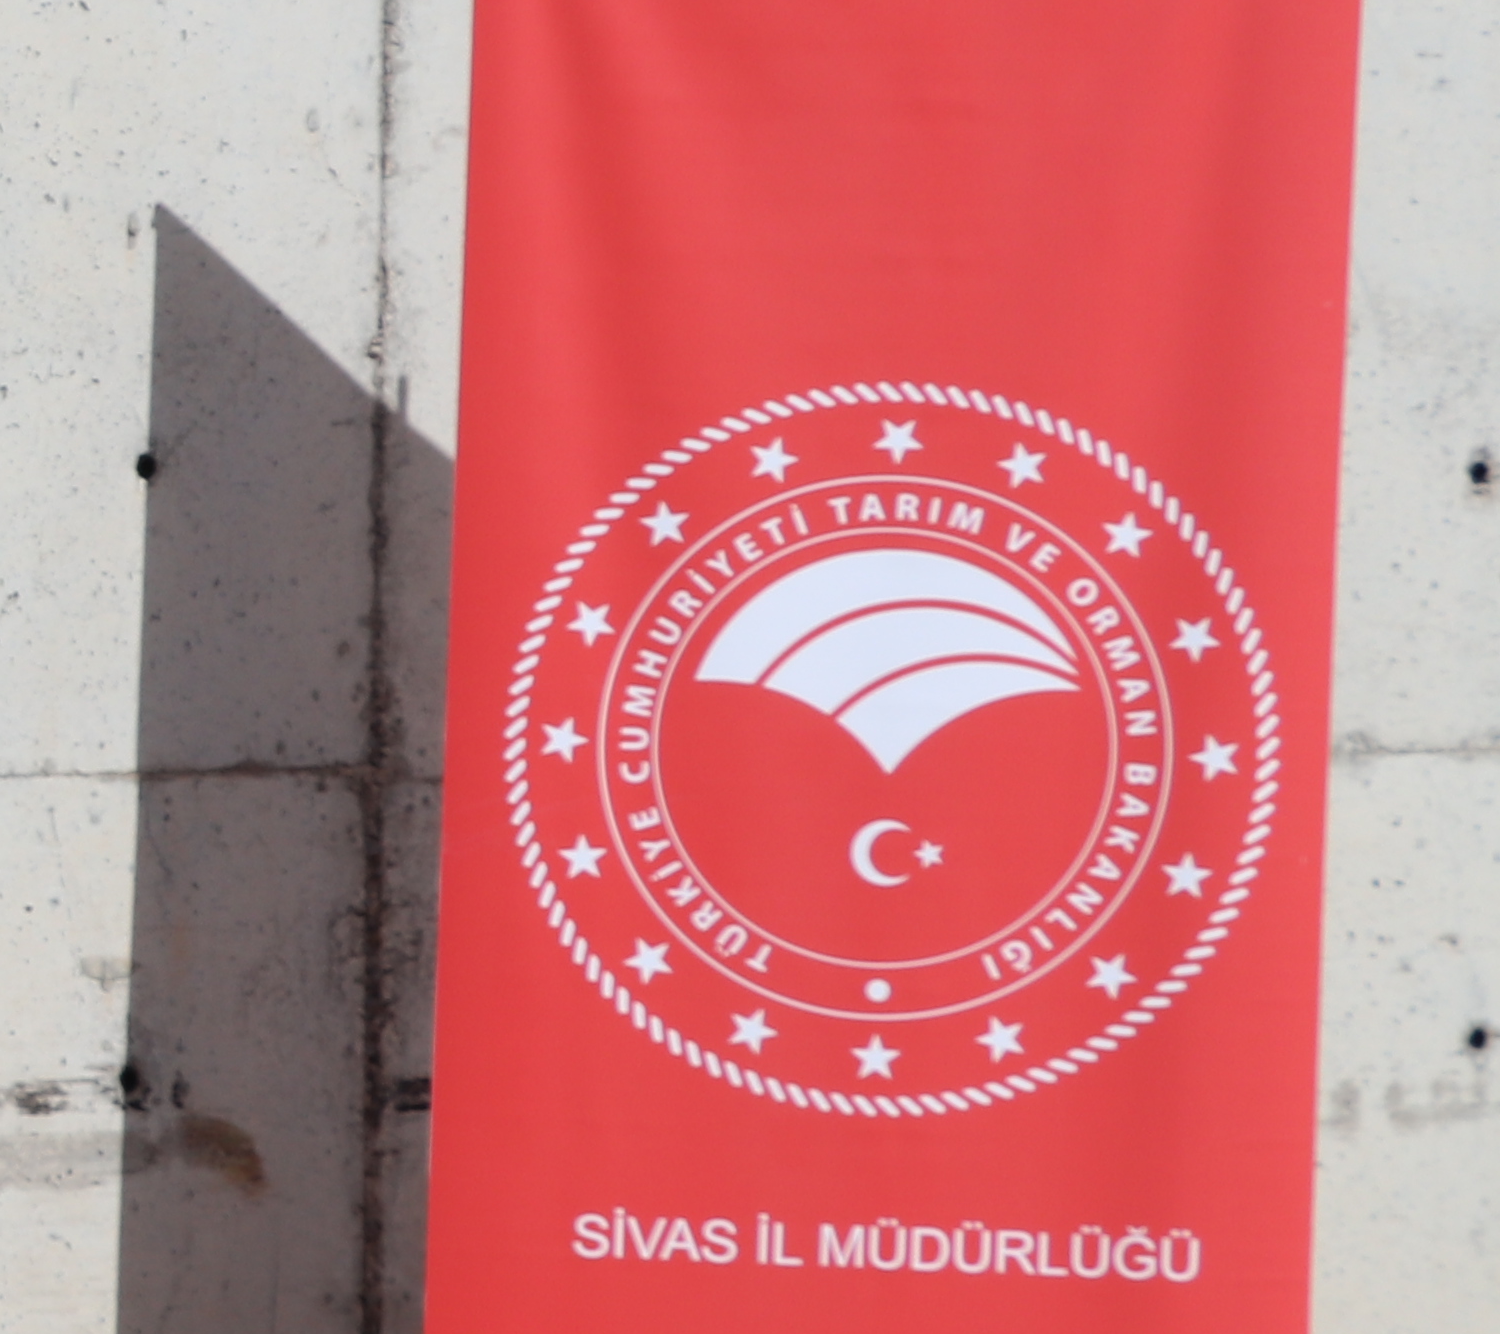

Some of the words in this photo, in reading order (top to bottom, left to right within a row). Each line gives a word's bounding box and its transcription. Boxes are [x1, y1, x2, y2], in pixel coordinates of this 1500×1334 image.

[827, 493, 985, 534] TARIM
[1005, 523, 1061, 572] VE
[618, 503, 809, 784] CUMHURİYETİ
[1066, 577, 1158, 737] ORMAN
[627, 806, 772, 973] TÜRKİYE
[980, 762, 1157, 981] BAKANLIĞI
[572, 1207, 739, 1264] SİVAS
[756, 1213, 804, 1267] İL
[818, 1217, 1201, 1282] MÜDÜRLÜĞÜ
